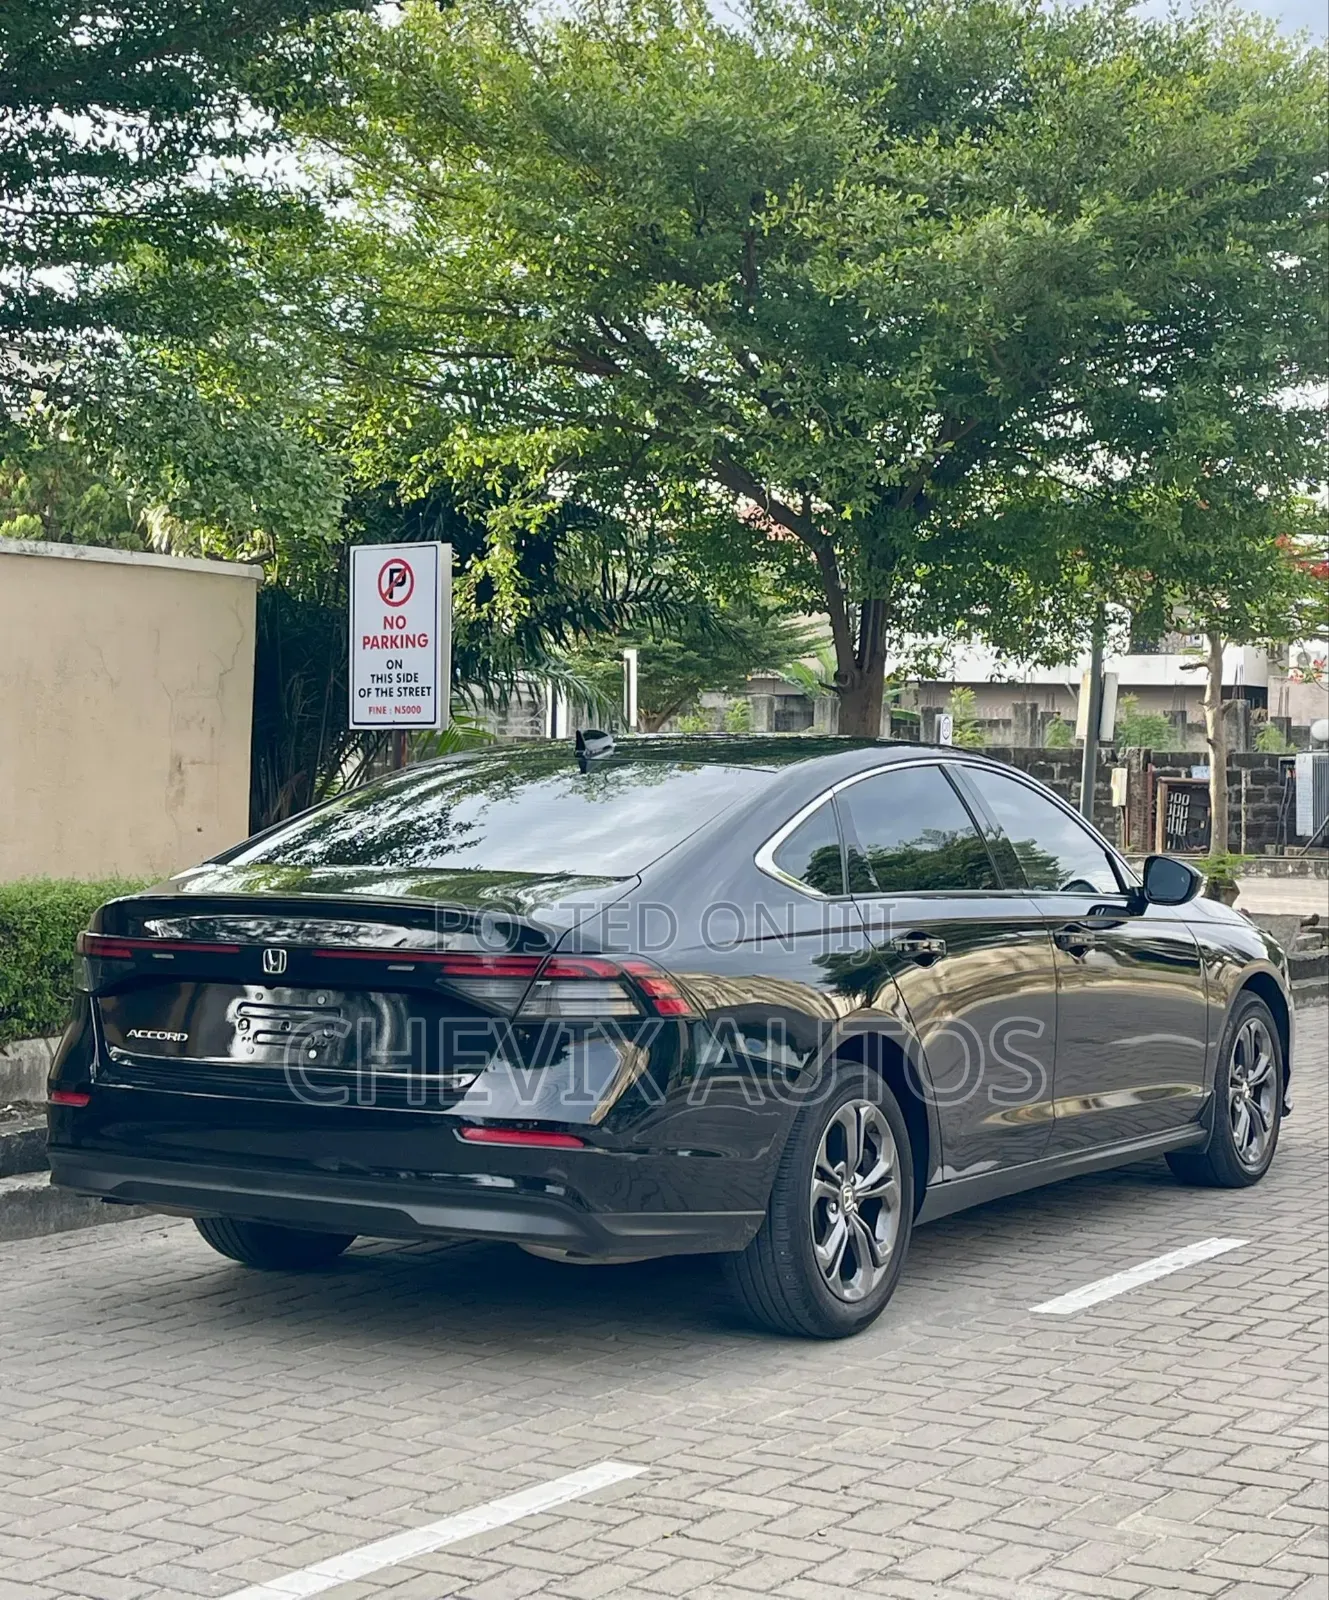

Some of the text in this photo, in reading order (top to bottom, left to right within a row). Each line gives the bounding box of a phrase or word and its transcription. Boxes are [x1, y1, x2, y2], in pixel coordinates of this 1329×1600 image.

[383, 615, 407, 630] NO
[362, 633, 429, 650] PARKING
[386, 659, 403, 670] ON
[370, 672, 419, 684] THIS SIDE
[358, 686, 432, 698] OF THE STREET
[368, 706, 387, 715] FINE
[394, 705, 421, 715] N5000
[126, 1029, 189, 1042] ACCORD
